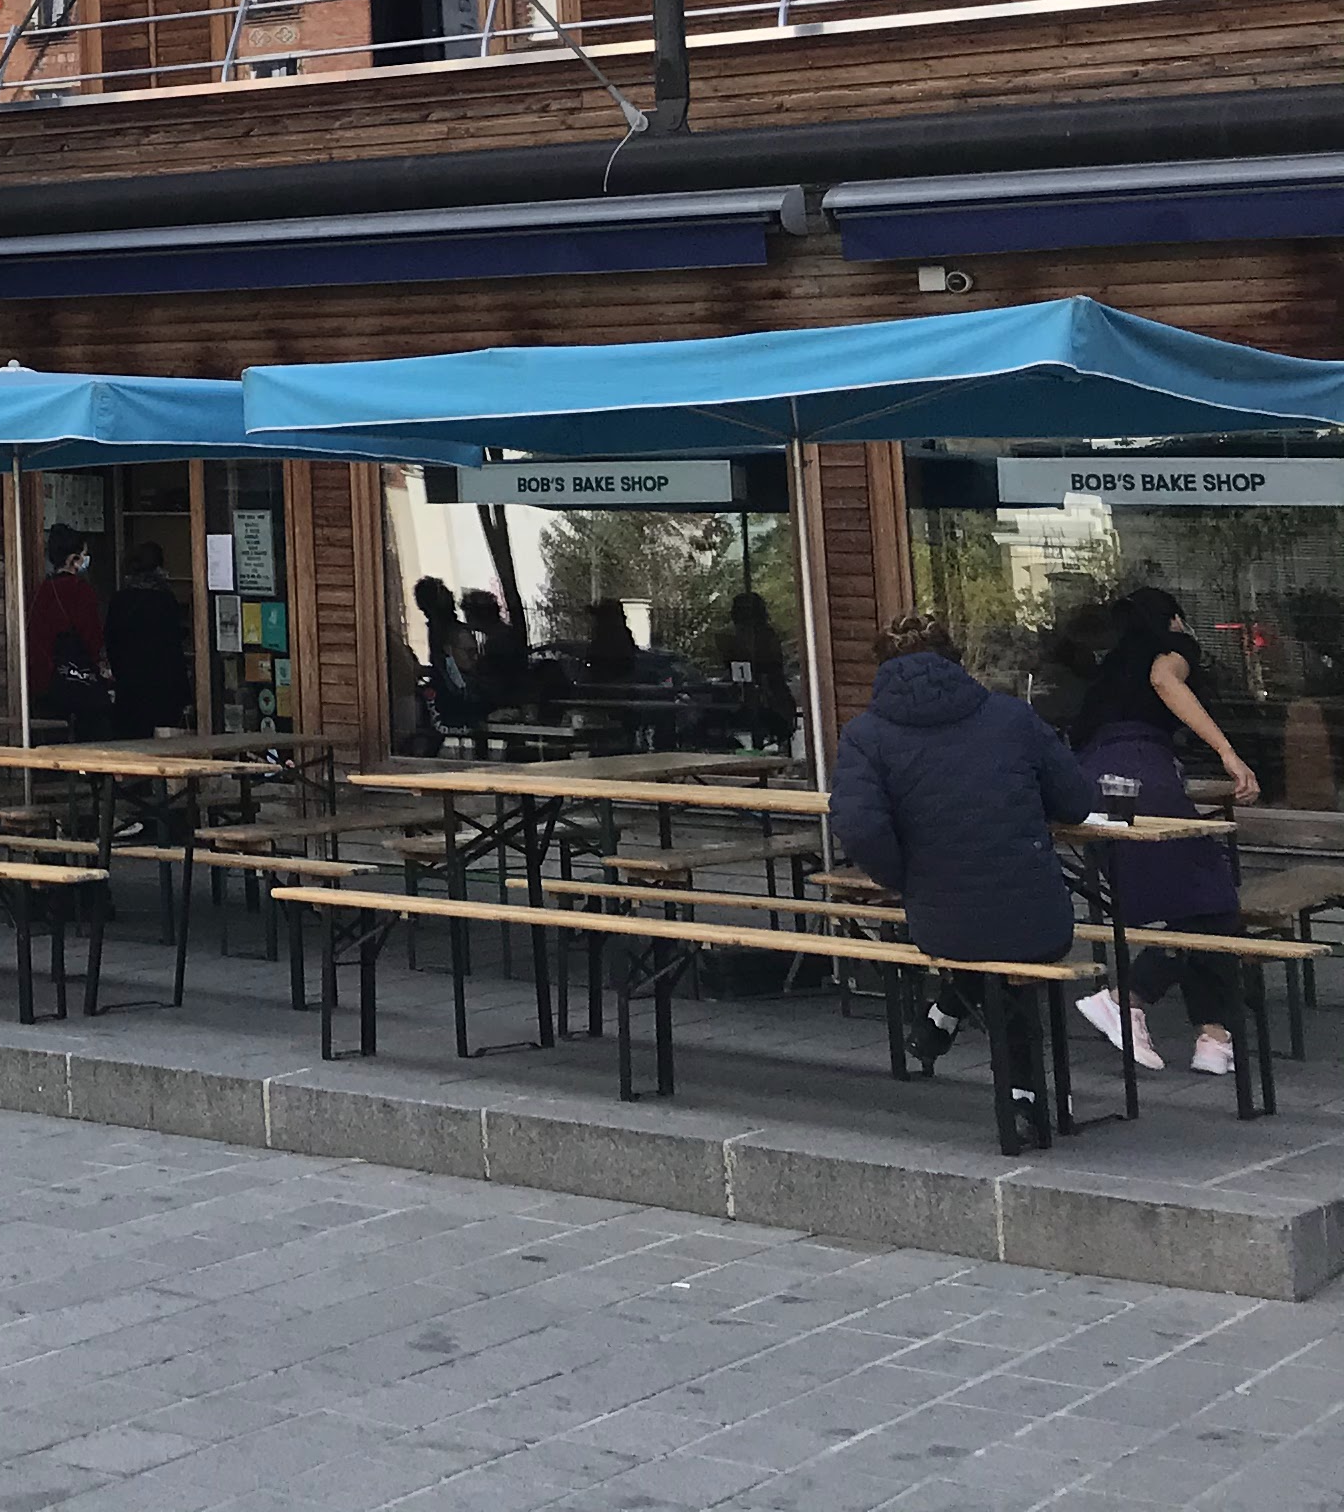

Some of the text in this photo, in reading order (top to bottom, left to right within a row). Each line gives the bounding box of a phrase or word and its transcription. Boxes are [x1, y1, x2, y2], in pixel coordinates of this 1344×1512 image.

[517, 476, 669, 493] BOB'S BAKE SHOP
[1070, 473, 1266, 492] BOB'S BAKE SHOP
[738, 665, 745, 679] 1
